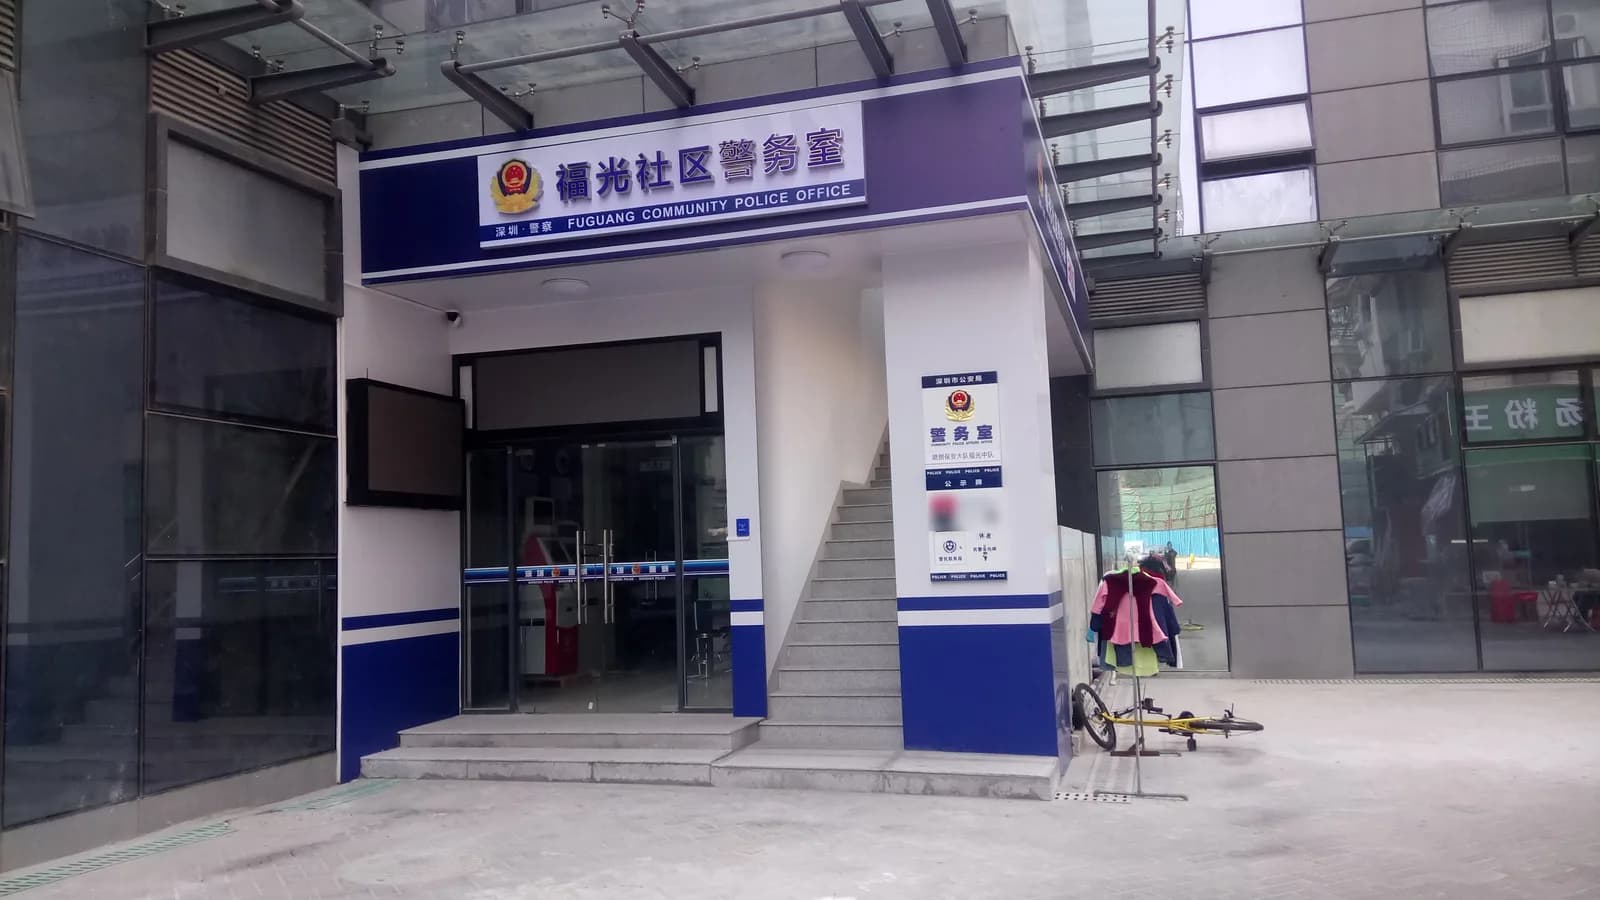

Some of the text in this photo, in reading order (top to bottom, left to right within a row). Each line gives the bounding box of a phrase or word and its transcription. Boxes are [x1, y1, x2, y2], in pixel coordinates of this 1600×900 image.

[556, 128, 844, 203] 福光社区警务室
[567, 183, 851, 229] FUGUANG COMMUNITY POLICE OFFICE
[935, 375, 983, 385] 深圳市公安局
[930, 425, 993, 443] 警务室
